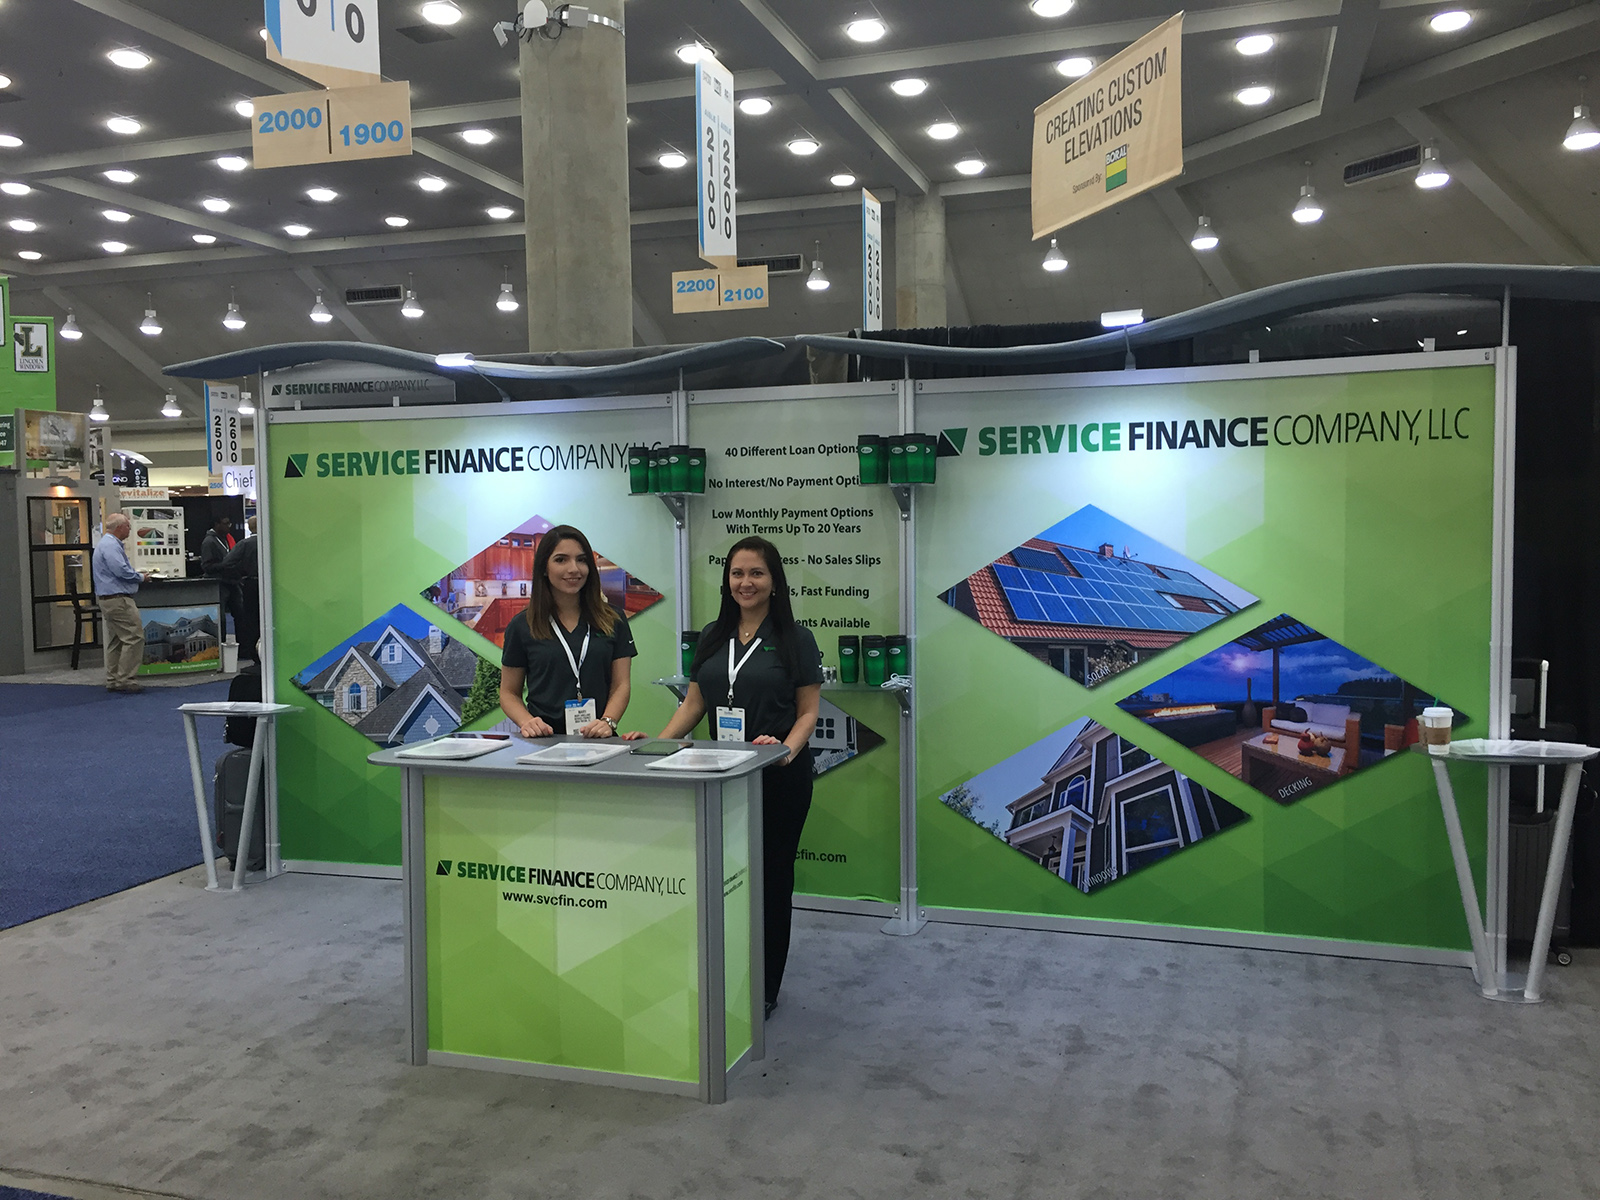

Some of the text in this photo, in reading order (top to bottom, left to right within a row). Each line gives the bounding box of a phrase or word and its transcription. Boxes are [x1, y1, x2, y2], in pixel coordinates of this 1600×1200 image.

[1046, 47, 1167, 144] CREATING CUSTOM
[259, 107, 322, 134] 2000
[340, 120, 403, 146] 1900
[1065, 98, 1142, 164] ELEVATIONS
[1106, 145, 1127, 164] BORAL
[706, 126, 716, 230] 2100
[722, 139, 732, 239] 2200
[677, 279, 715, 293] 2200
[724, 287, 764, 302] 2100
[285, 383, 330, 395] SERVICE
[332, 381, 373, 394] FINANCE
[214, 415, 223, 462] 2500
[229, 417, 238, 463] 2600
[979, 407, 1470, 456] SERVICE FINANCE COMPANY, LLC
[316, 442, 629, 478] SERVICE FINANCE COMPANY,
[725, 447, 738, 457] 40
[741, 446, 787, 457] Different
[789, 445, 816, 455] Loan
[225, 470, 253, 489] Chief
[709, 475, 860, 489] No Interest/No Payment Opti
[120, 489, 165, 497] evitalize
[712, 507, 874, 521] Low Monthly Payment Options
[726, 523, 861, 535] With Terms Up To 20 Years
[807, 555, 823, 565] No
[825, 554, 852, 565] Sales
[855, 554, 881, 567] Slips
[801, 586, 823, 596] Fast
[825, 586, 870, 599] Funding
[820, 617, 870, 628] Available
[1086, 665, 1111, 683] SOLAR
[1278, 776, 1313, 799] DECKING
[795, 848, 847, 863] cfin.com
[457, 861, 686, 896] SERVICE FINANCE COMPANY, LLC
[502, 891, 607, 909] www.svcfin.com
